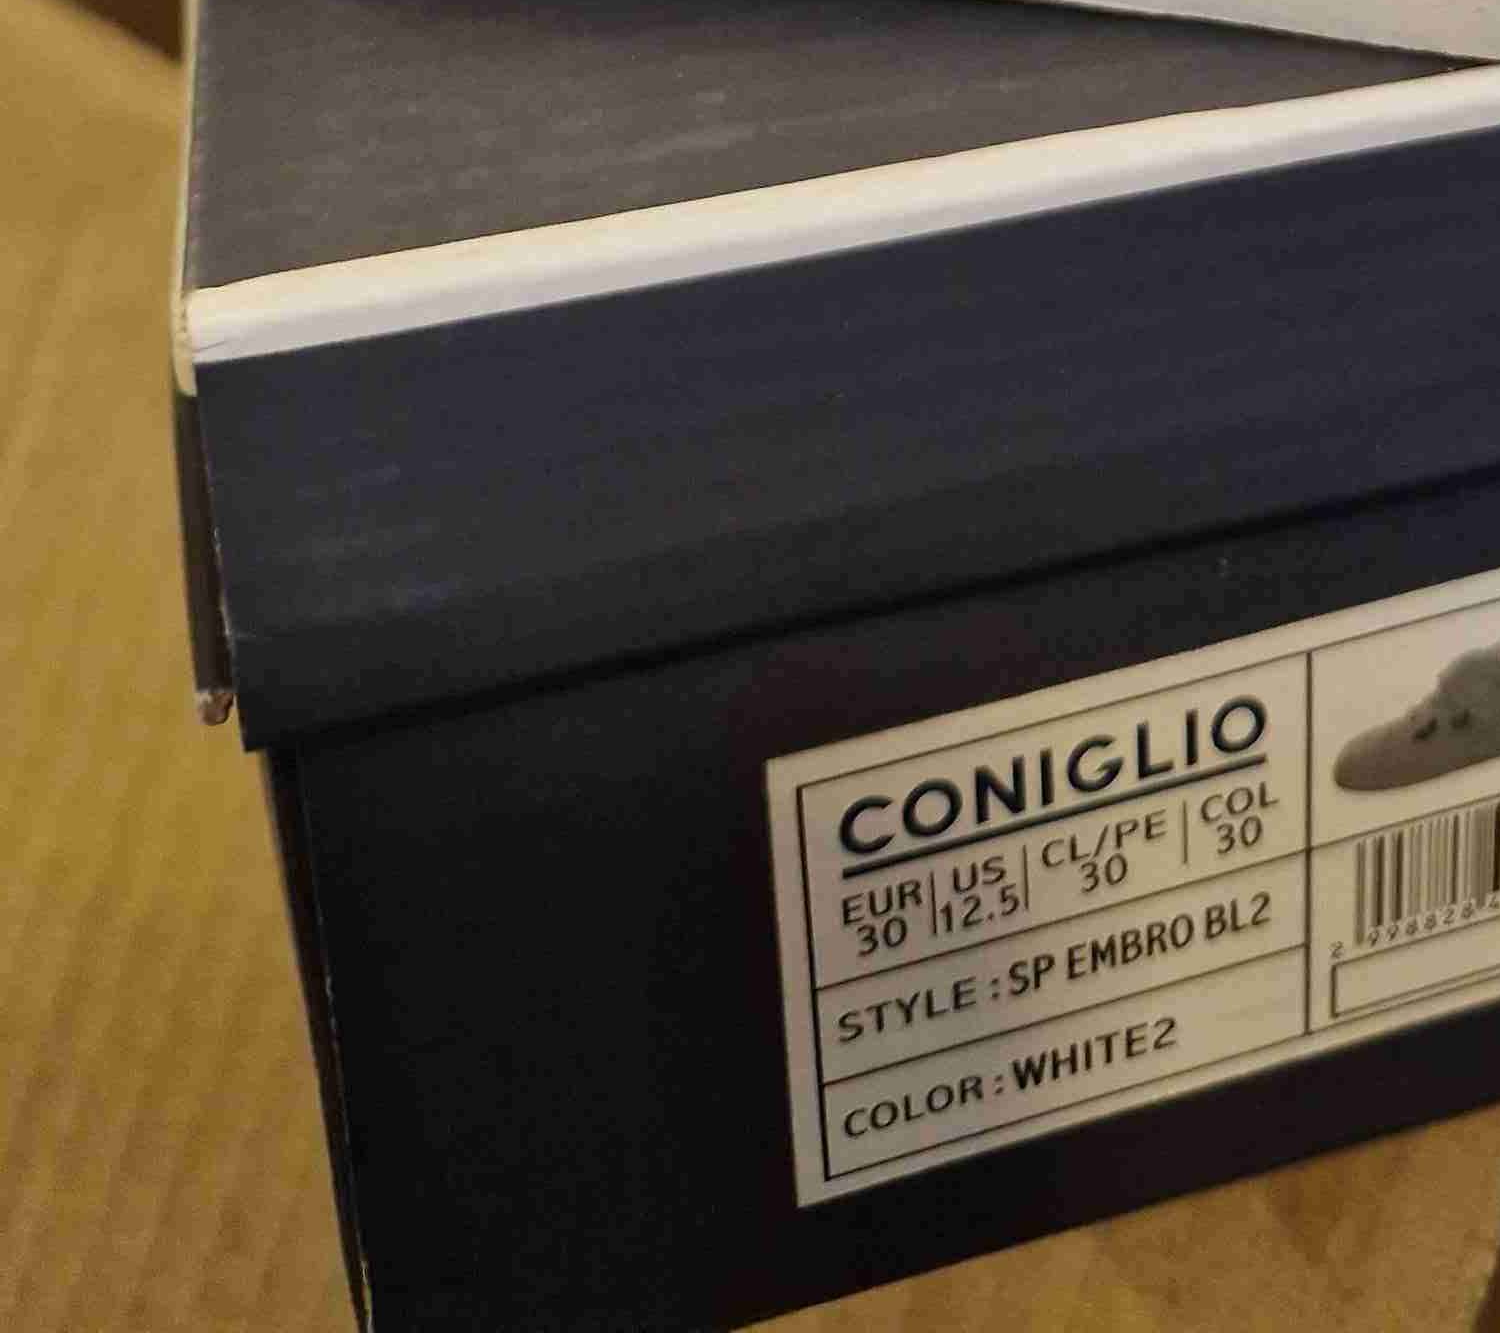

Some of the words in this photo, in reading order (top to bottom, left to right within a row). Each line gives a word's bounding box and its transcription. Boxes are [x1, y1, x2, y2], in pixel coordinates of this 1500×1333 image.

[839, 694, 1267, 855] CONIGLIO
[842, 879, 923, 925] EUR
[952, 855, 1007, 894] US
[1040, 809, 1169, 868] CL/PE
[1199, 780, 1279, 824] COL
[857, 916, 907, 957] 30
[938, 883, 1020, 933] 12.5
[1080, 852, 1128, 894] 30
[1216, 816, 1263, 855] 30
[1007, 953, 1056, 997] SP
[1066, 913, 1194, 980] EMBRO
[1203, 890, 1273, 941] BL2
[1011, 1016, 1178, 1092] WHITE2
